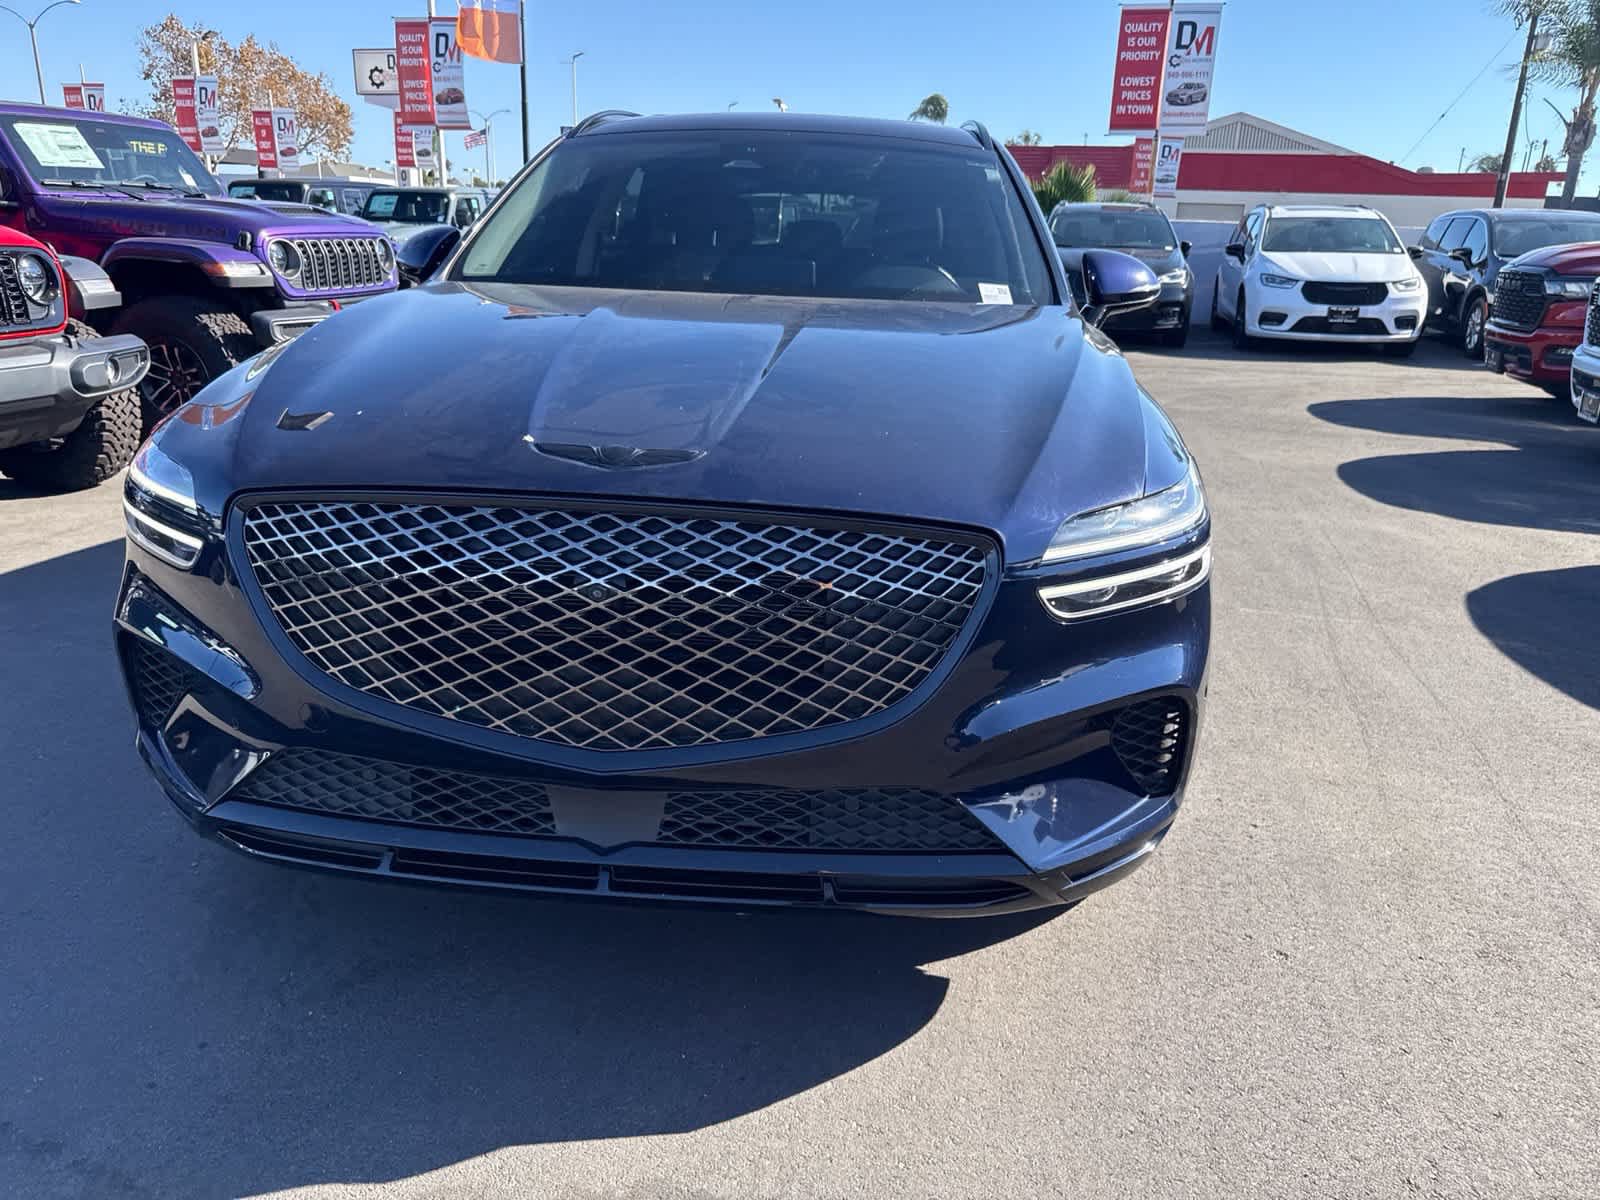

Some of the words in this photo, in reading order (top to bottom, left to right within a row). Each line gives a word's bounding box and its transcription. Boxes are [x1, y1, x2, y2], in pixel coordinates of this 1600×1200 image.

[1124, 22, 1163, 33] QUALITY
[399, 33, 426, 43] QUALITY
[1127, 36, 1136, 47] IS
[1137, 37, 1157, 47] OUR
[402, 46, 408, 54] IS
[408, 46, 423, 55] OUR
[1120, 50, 1161, 61] PRIORITY
[400, 58, 429, 66] PRIORITY
[403, 80, 428, 89] LOWEST
[1120, 75, 1156, 86] LOWEST
[1121, 90, 1152, 101] PRICES
[1116, 104, 1128, 115] IN
[1128, 105, 1154, 115] TOWN
[129, 140, 156, 154] THE
